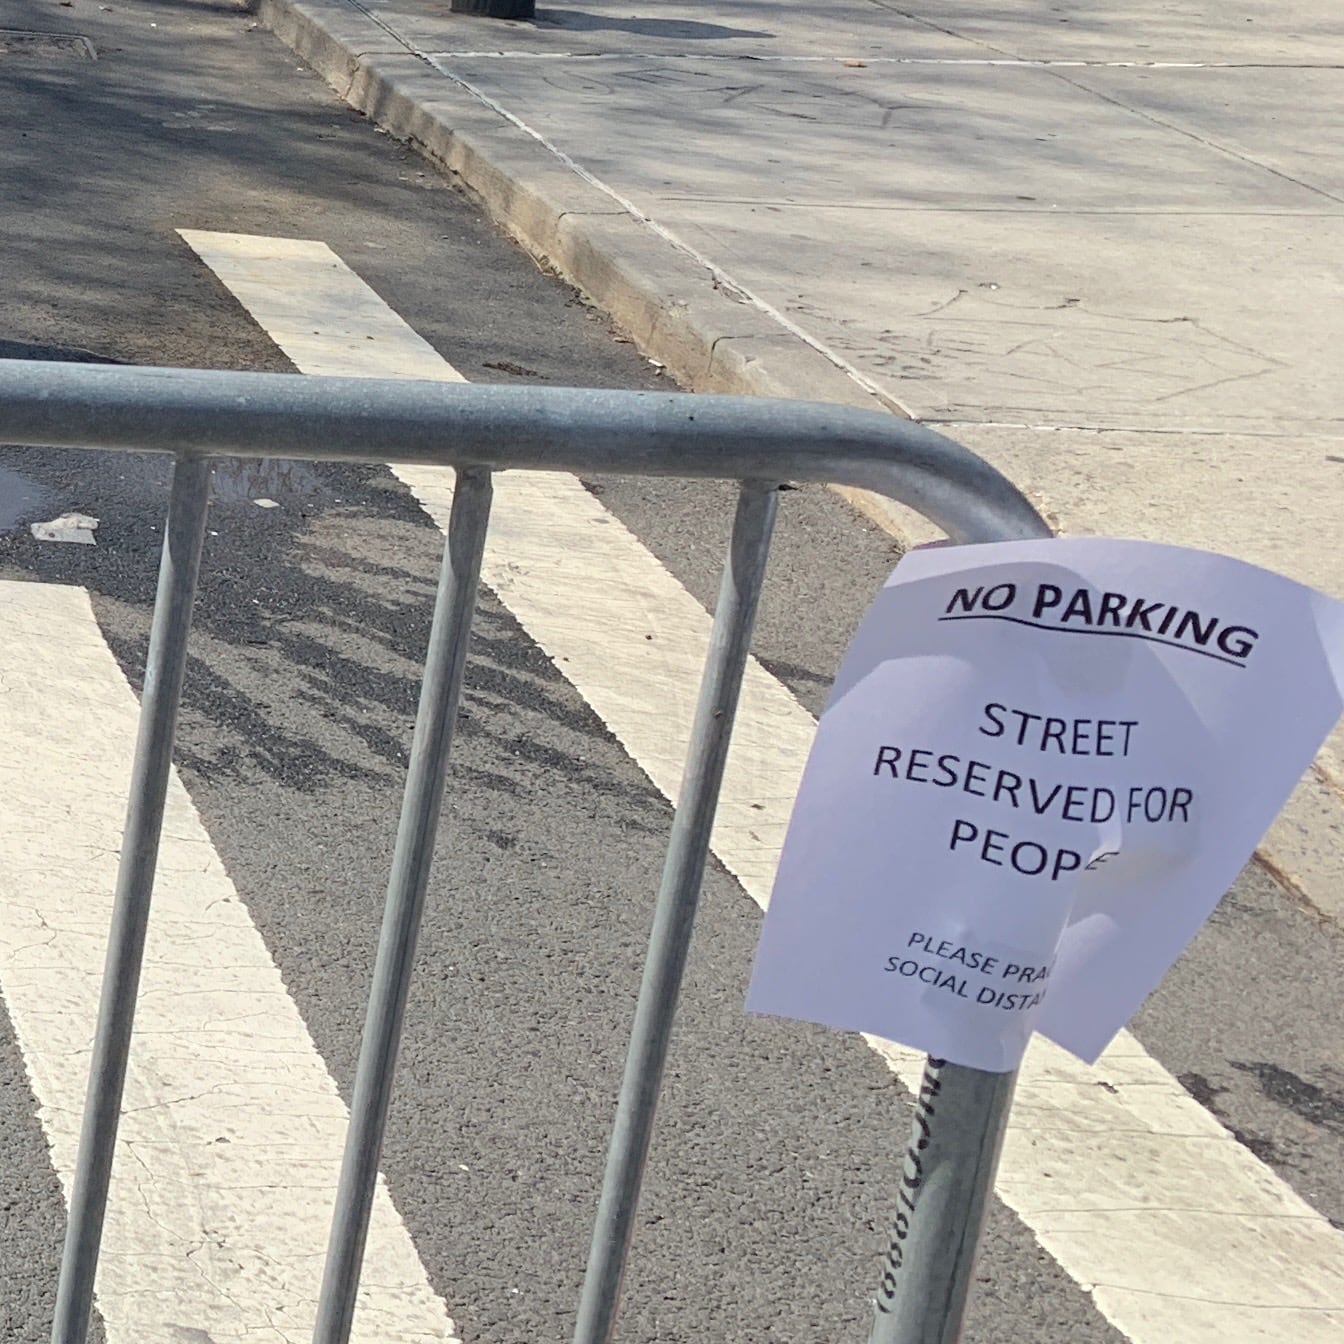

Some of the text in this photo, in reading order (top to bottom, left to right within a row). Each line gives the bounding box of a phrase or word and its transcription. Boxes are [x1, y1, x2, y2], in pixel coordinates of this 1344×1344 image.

[945, 582, 1260, 660] NO PARKING
[978, 702, 1139, 757] STREET
[873, 745, 1193, 824] RESERVED FOR
[884, 956, 1048, 1011] SOCIAL DISTA
[907, 932, 1051, 984] PLEASE PRA
